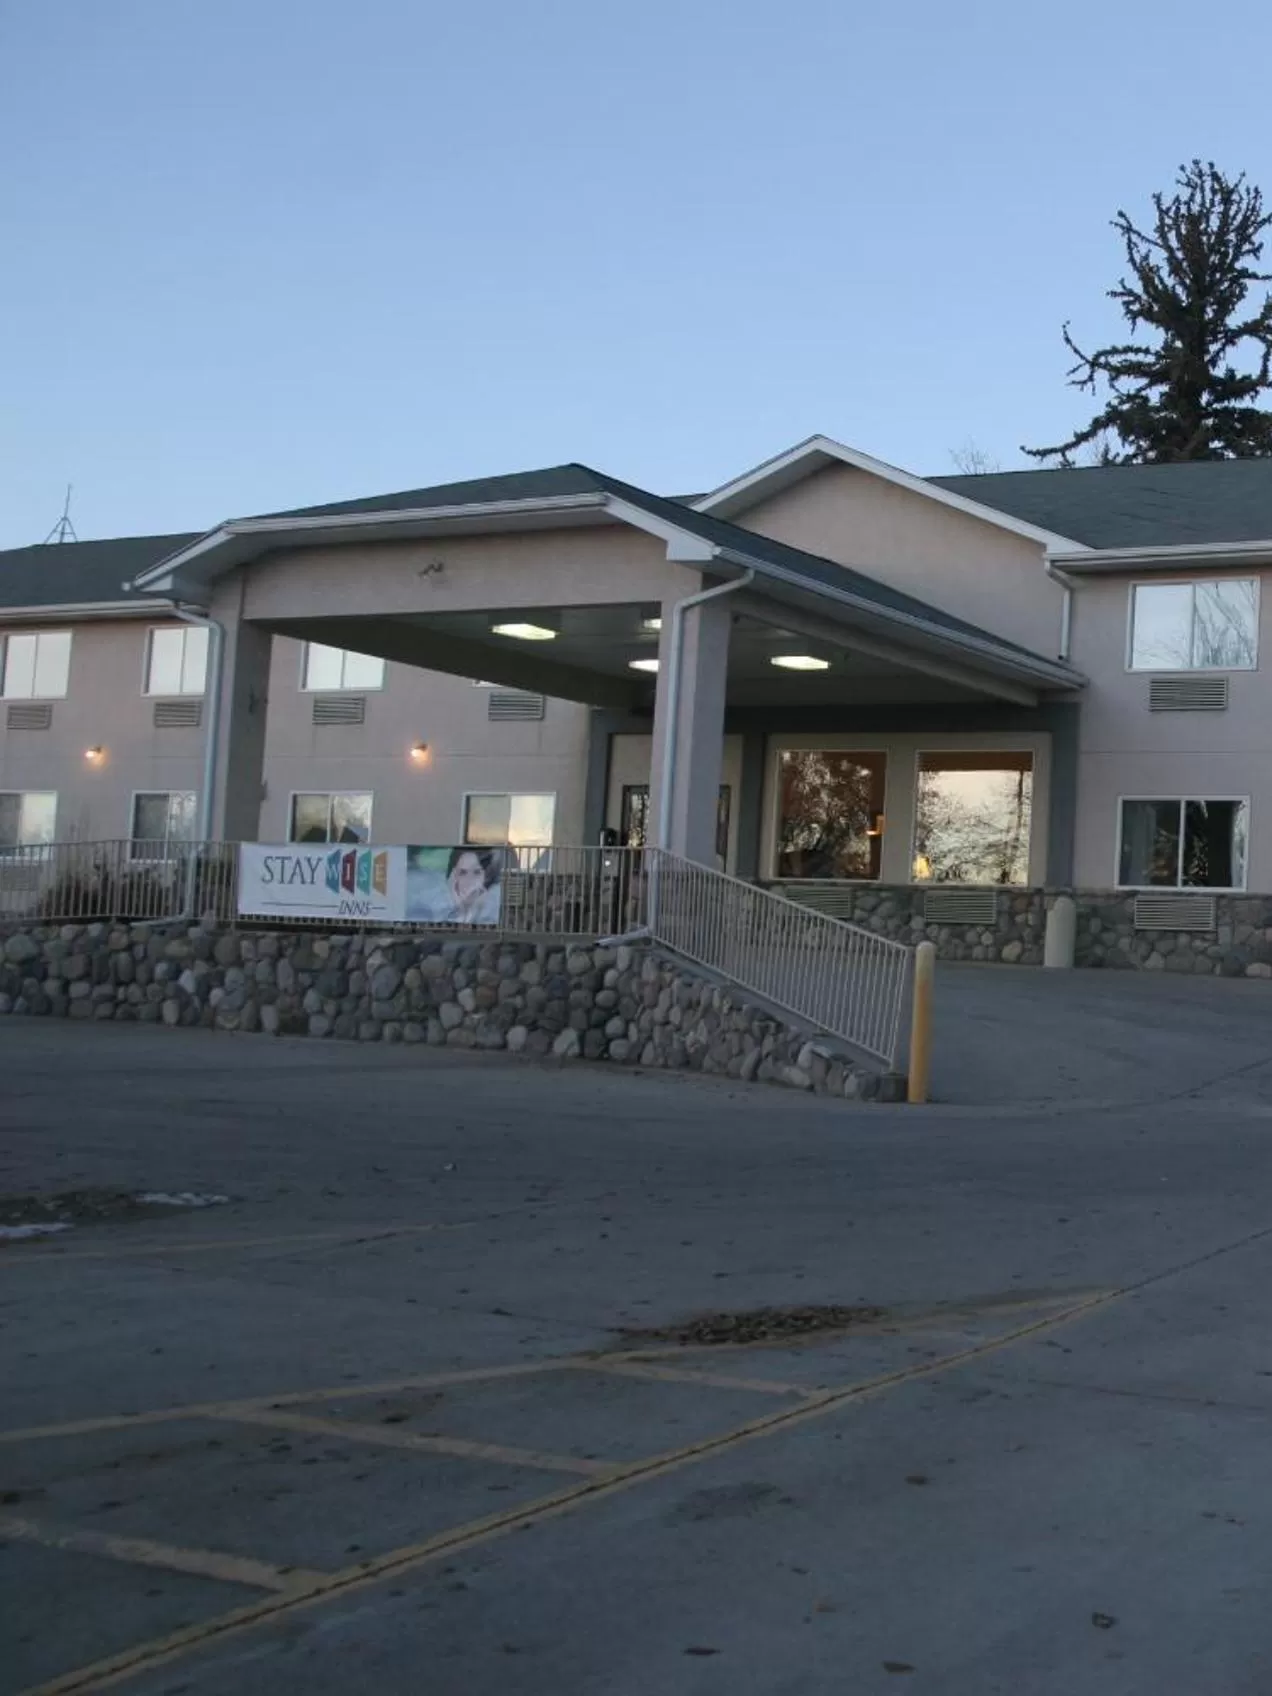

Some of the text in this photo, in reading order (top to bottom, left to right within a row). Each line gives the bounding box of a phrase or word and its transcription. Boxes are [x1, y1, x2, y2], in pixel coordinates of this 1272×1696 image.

[261, 856, 385, 885] STAY WISE
[338, 900, 371, 916] INNS
